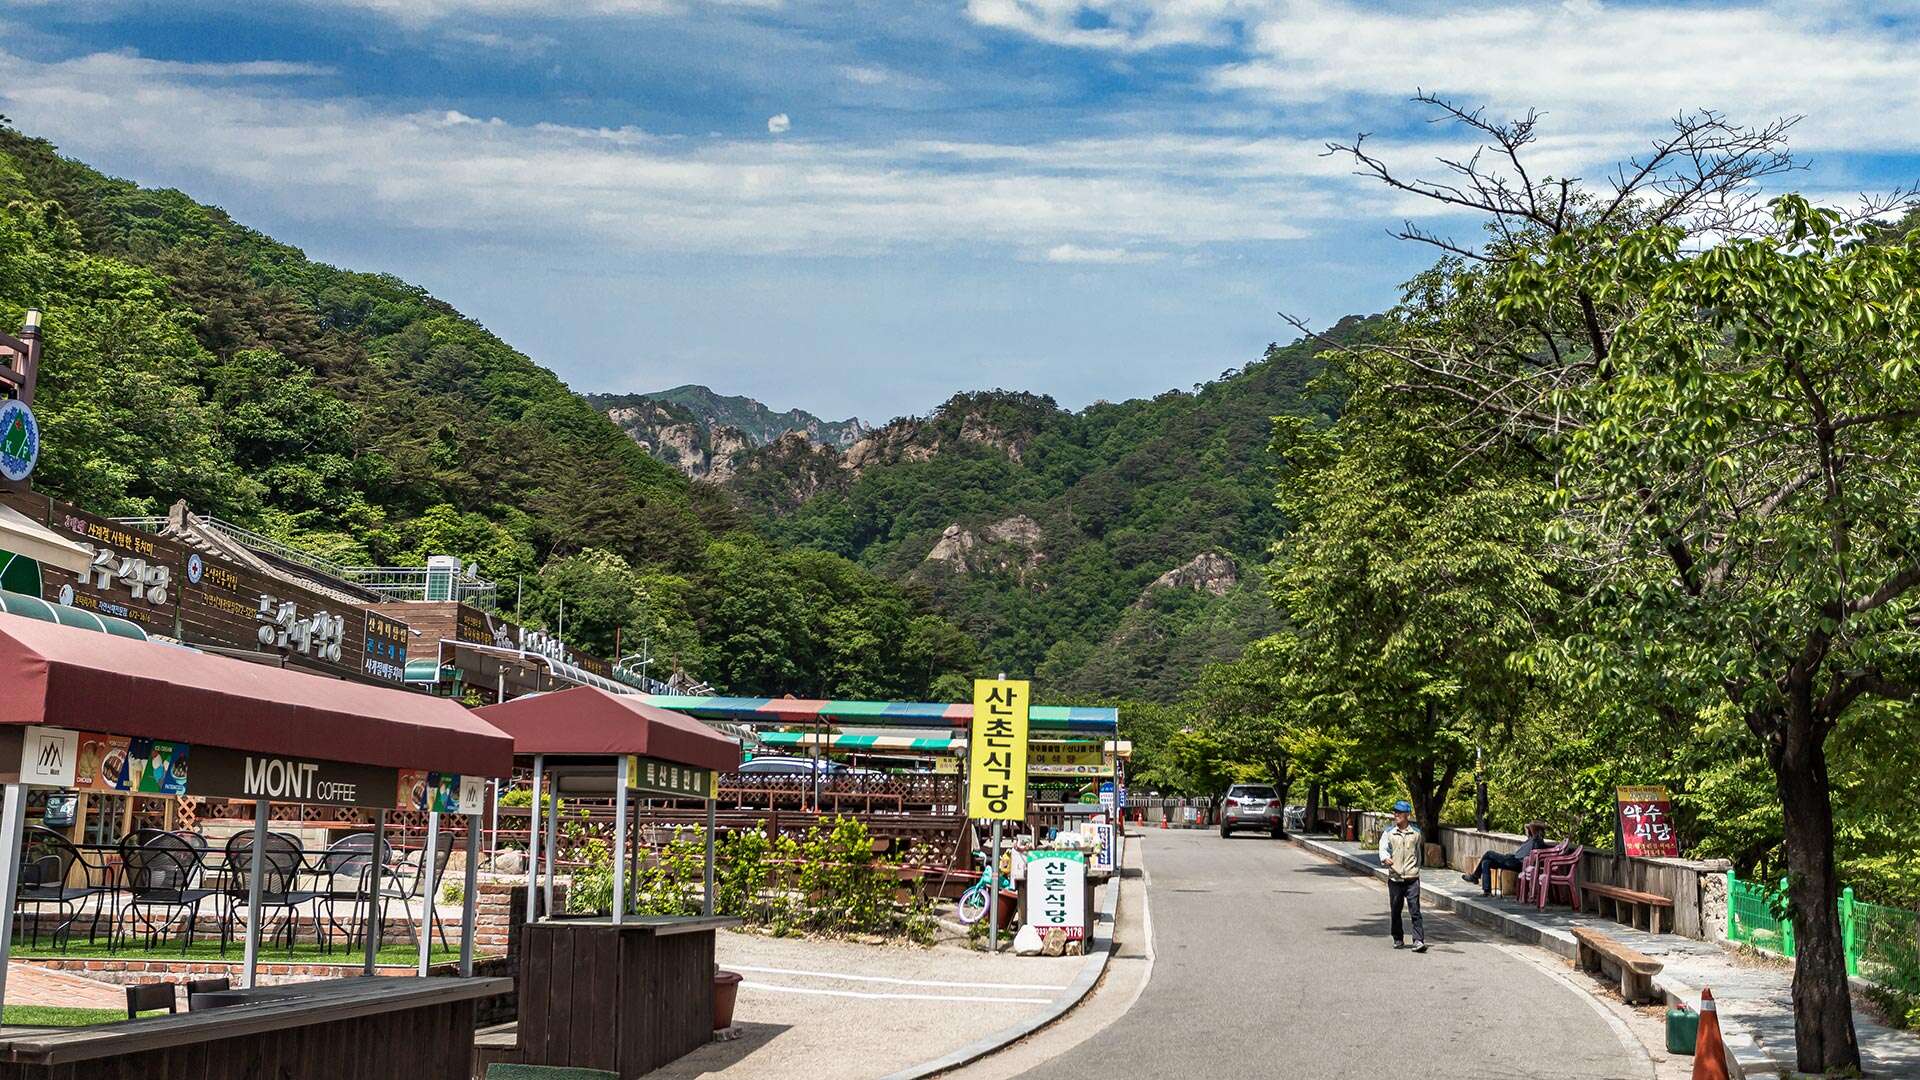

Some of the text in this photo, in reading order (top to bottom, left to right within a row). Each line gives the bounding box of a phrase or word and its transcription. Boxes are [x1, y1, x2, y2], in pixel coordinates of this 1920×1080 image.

[982, 687, 1018, 814] 산촌식당
[244, 757, 356, 802] MONT COFFEE
[1623, 804, 1663, 822] 약수
[1634, 823, 1672, 841] 식당
[1043, 862, 1068, 924] 산촌식당
